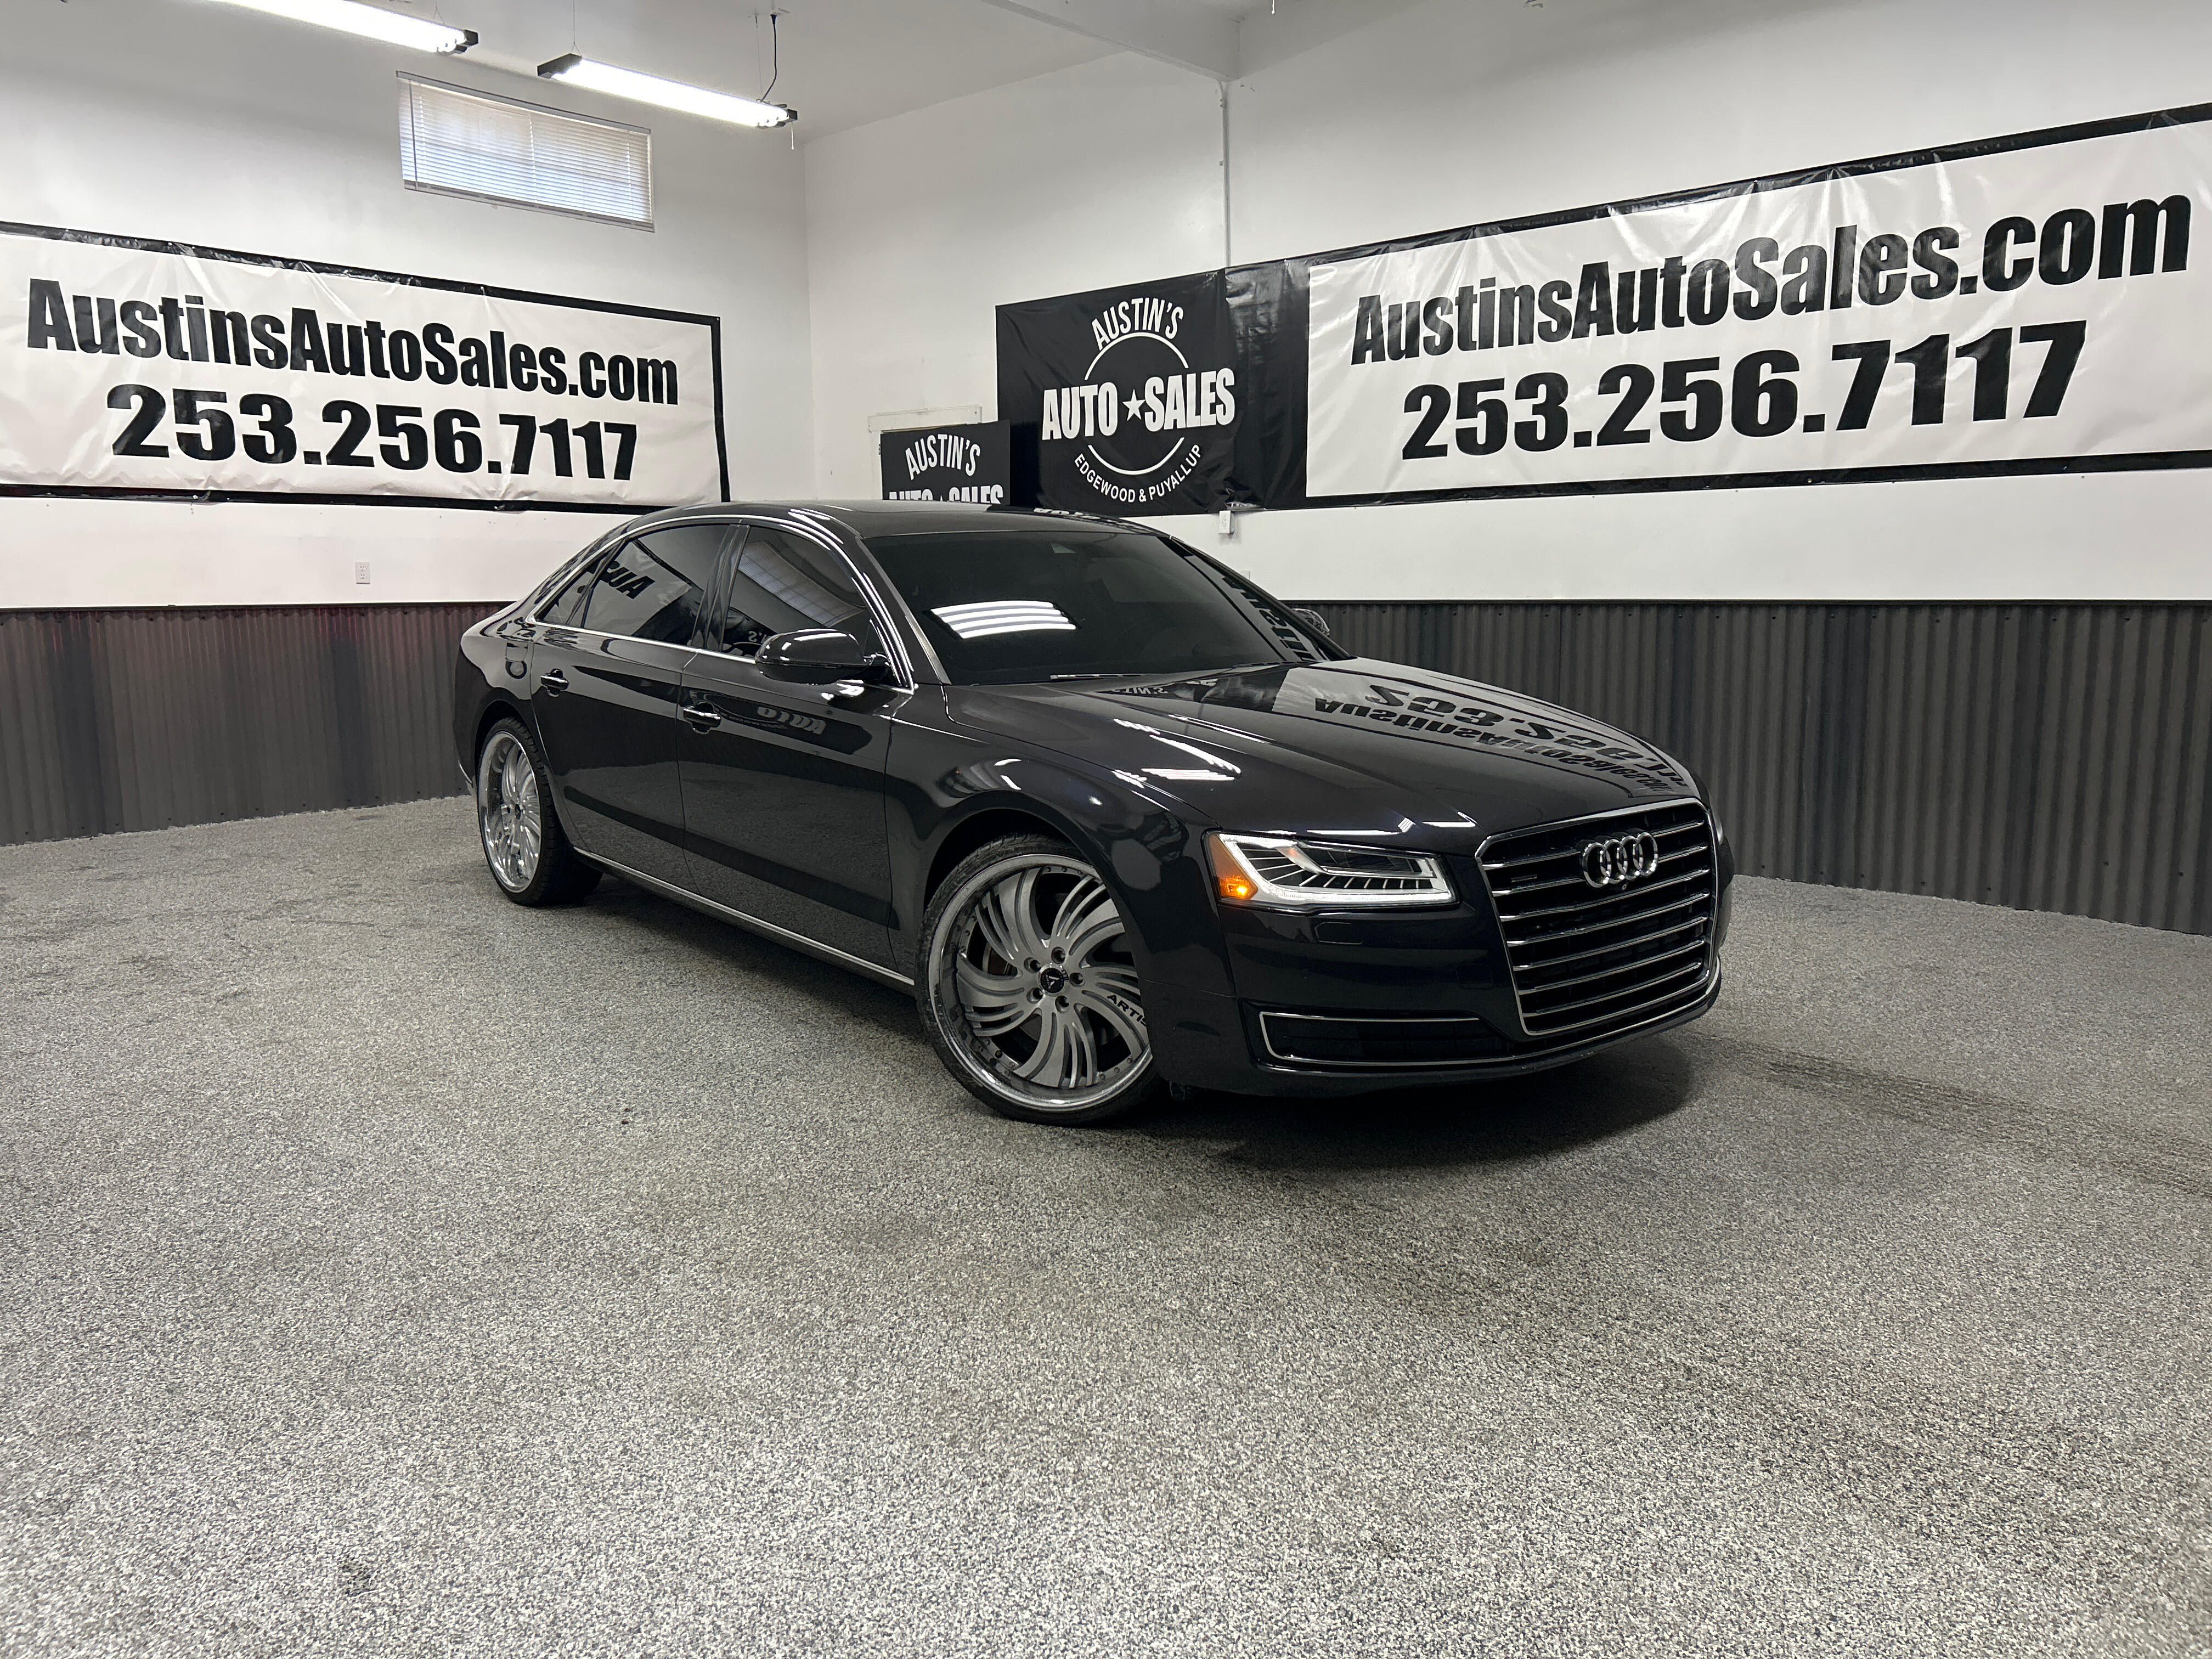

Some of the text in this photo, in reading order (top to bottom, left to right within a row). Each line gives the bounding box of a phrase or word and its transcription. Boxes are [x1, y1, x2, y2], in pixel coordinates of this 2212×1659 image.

[1351, 194, 2191, 364] AustinsAutoSales.com
[28, 279, 679, 405] AustinsAutoSales.com
[1092, 297, 1184, 351] AUSTIN'S
[106, 384, 638, 481] 253.256.7117
[1042, 368, 1235, 441] AUTO SALES
[1402, 320, 2086, 460] 253.256.7117
[905, 434, 980, 480] AUSTIN'S
[1074, 444, 1202, 503] EDGEWOOD & PUYALLUP
